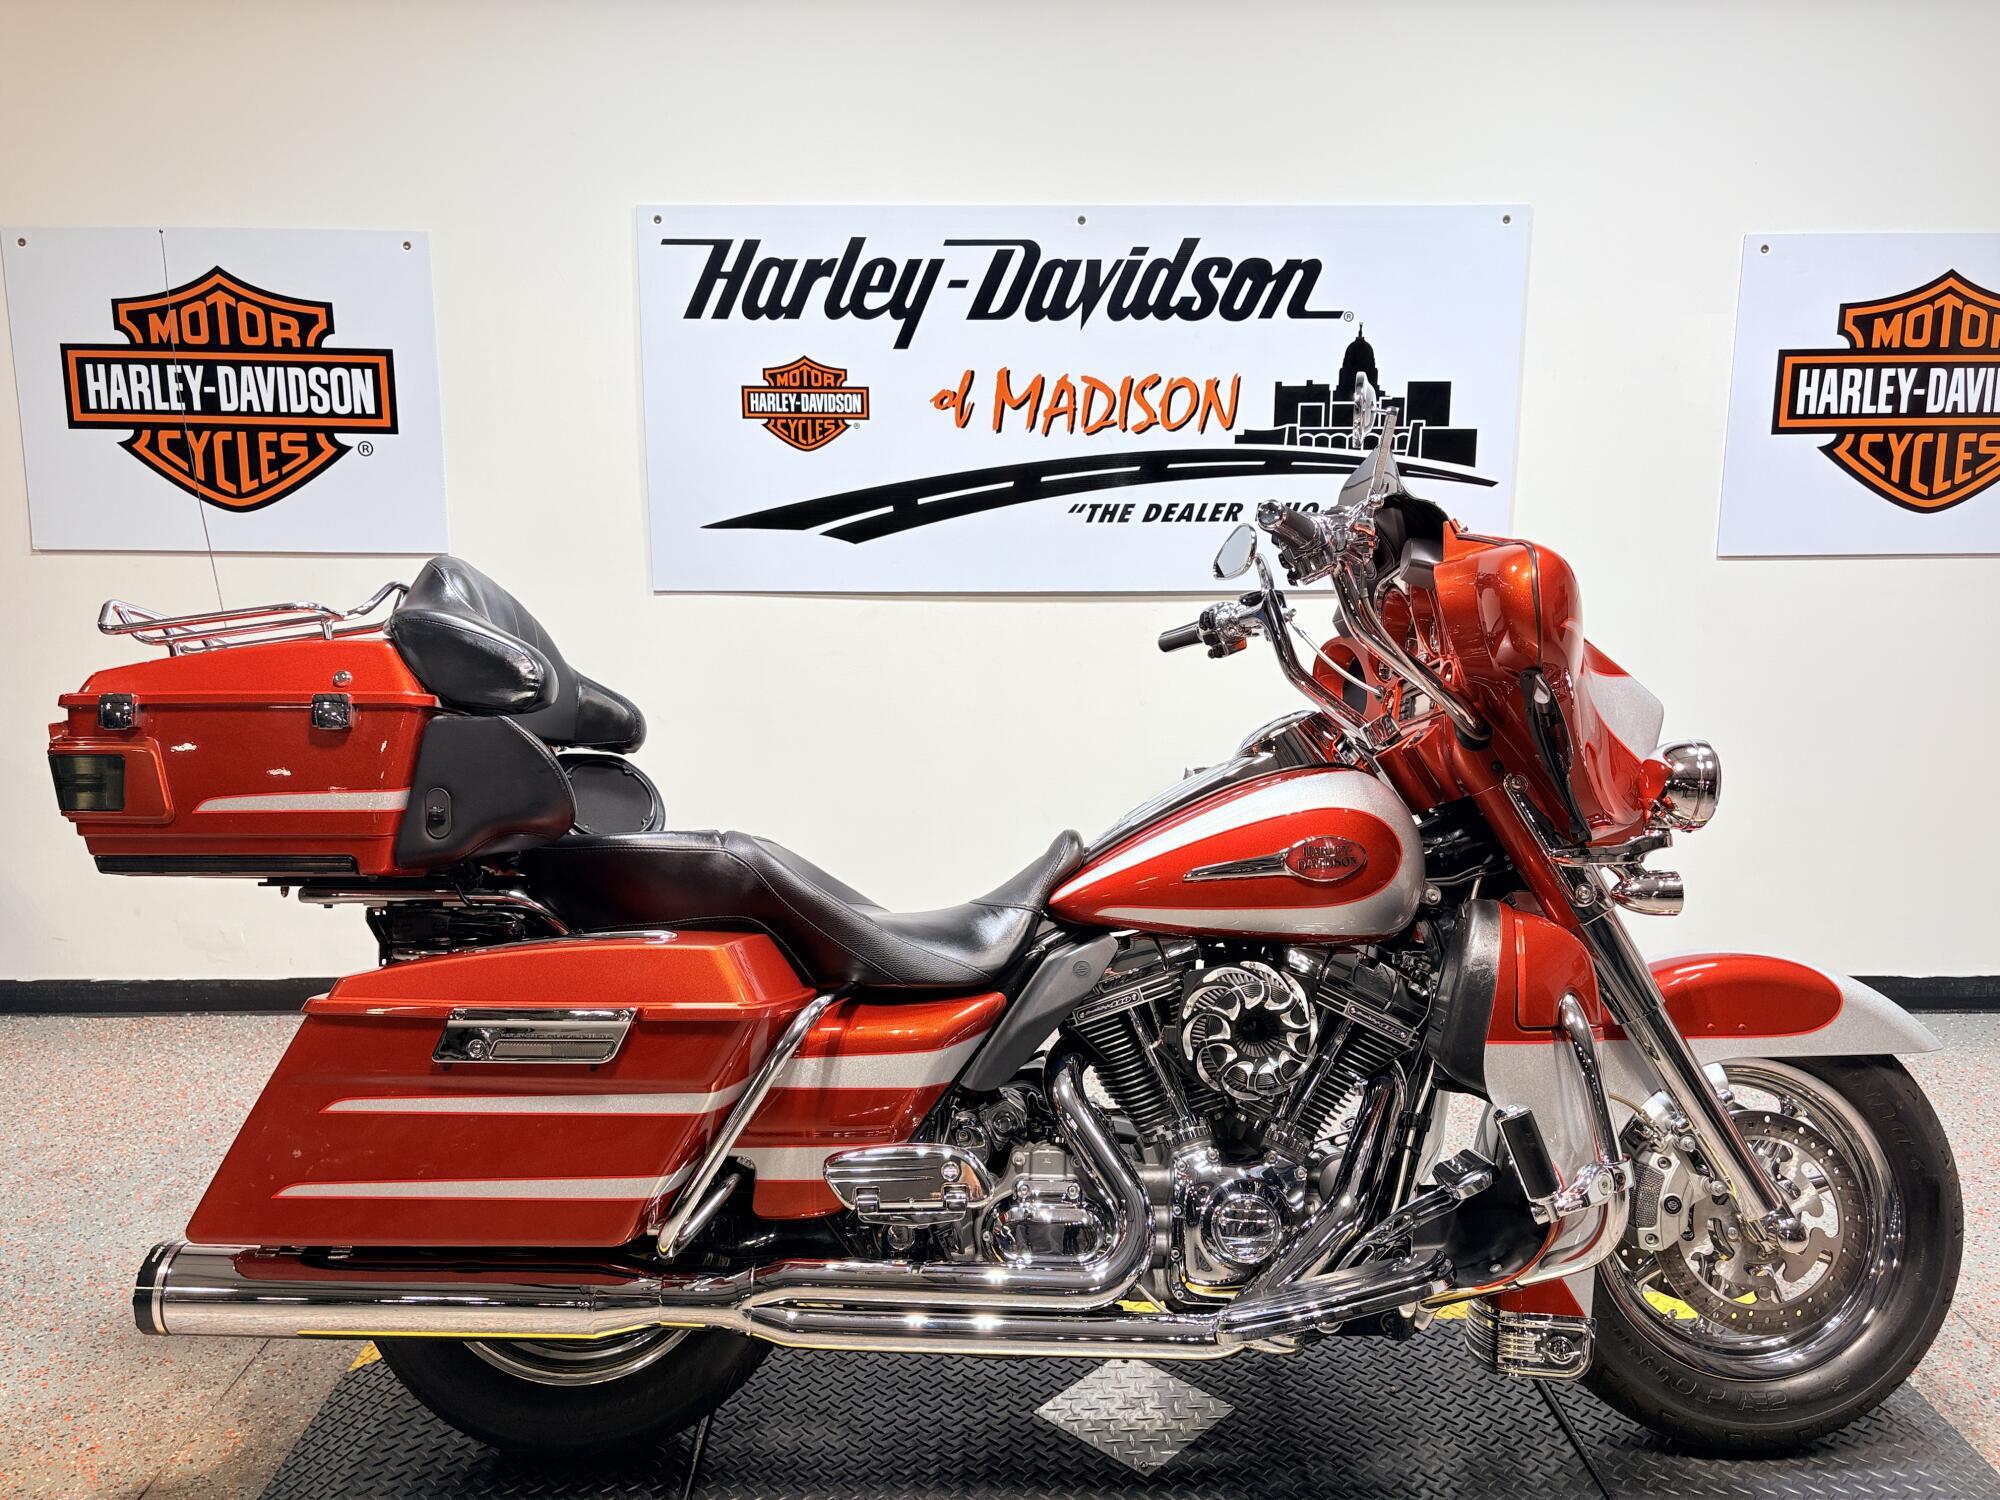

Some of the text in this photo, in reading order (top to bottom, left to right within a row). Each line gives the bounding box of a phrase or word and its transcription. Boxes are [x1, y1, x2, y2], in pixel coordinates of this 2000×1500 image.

[148, 290, 302, 347] MOTOR
[85, 363, 376, 415] HARLEY-DAVIDSON
[776, 365, 835, 387] MOTOR
[1796, 367, 2000, 415] HARLEY-DAVI
[750, 392, 862, 413] HARLEY-DAVIDSON
[930, 366, 1241, 437] of MADISON
[776, 419, 836, 445] CYCLES
[158, 429, 309, 495] CYCLES
[1859, 432, 2000, 497] CYCLES
[1142, 502, 1244, 523] DEALER
